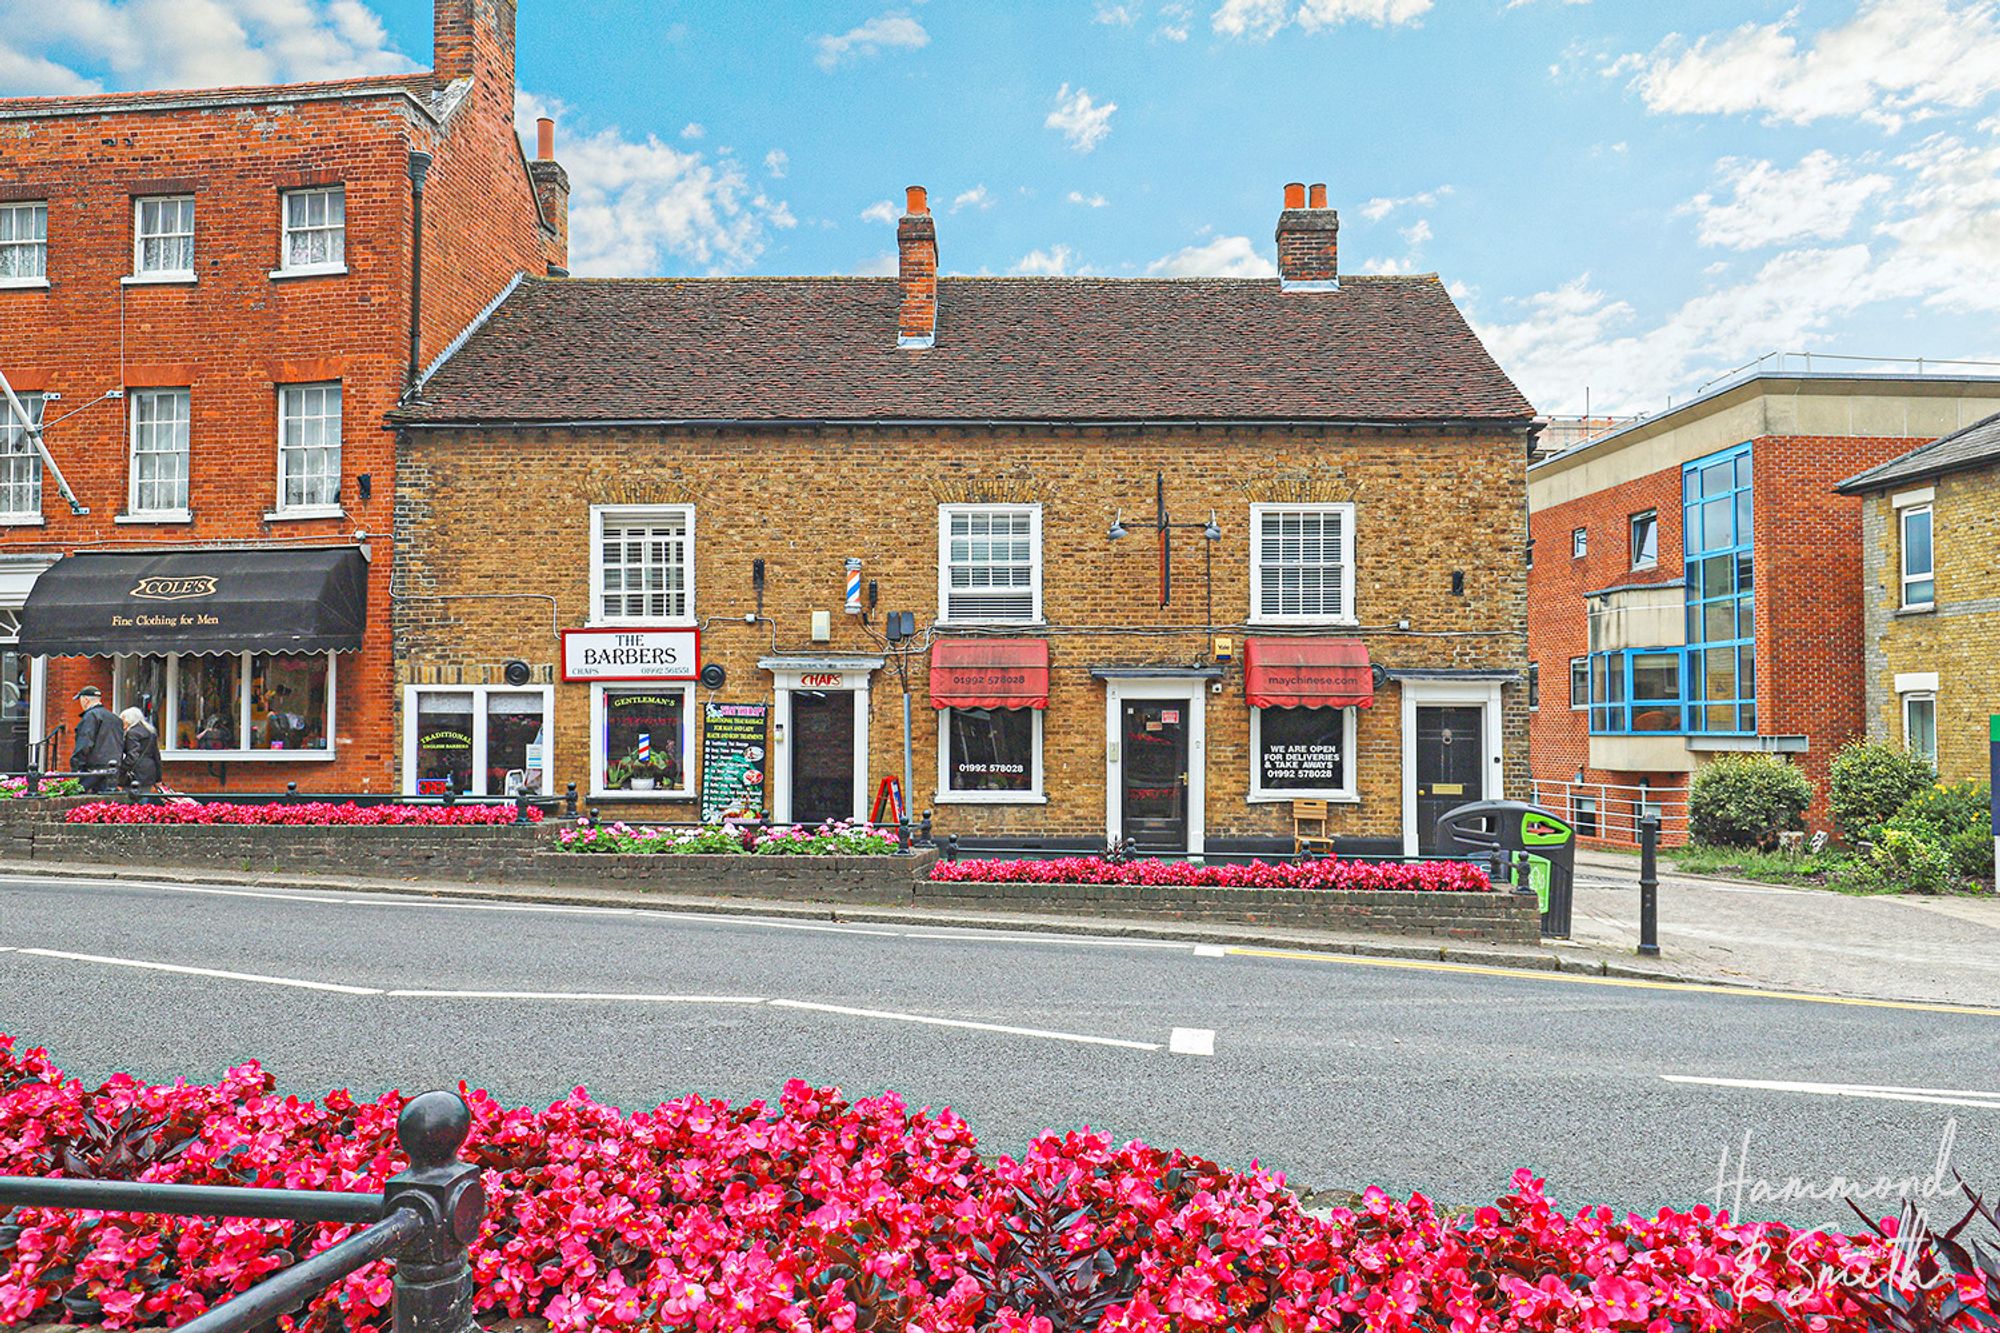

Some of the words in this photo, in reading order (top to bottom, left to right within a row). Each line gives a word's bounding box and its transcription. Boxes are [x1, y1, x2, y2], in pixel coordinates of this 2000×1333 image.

[145, 581, 208, 594] COLE'S
[111, 615, 133, 626] Fine
[135, 615, 177, 627] Clothing
[180, 614, 194, 625] for
[197, 615, 219, 624] Men
[615, 635, 645, 646] THE
[584, 648, 677, 665] BARBERS
[801, 673, 842, 687] CHAPS
[953, 676, 985, 684] 01992
[987, 676, 1025, 684] 578028
[1268, 676, 1359, 686] maychinese.com
[614, 696, 676, 707] GENTLEMAN'S
[420, 731, 472, 744] TRADITIONAL
[1270, 745, 1285, 753] WE
[1287, 745, 1307, 753] ARE
[1309, 745, 1336, 753] OPEN
[959, 764, 987, 772] 01992
[989, 764, 1024, 773] 578028
[1264, 761, 1272, 769] &
[1274, 761, 1299, 769] TAKE
[1302, 761, 1334, 769] AWAYS
[1267, 769, 1295, 778] 01992
[1297, 769, 1332, 778] 578028
